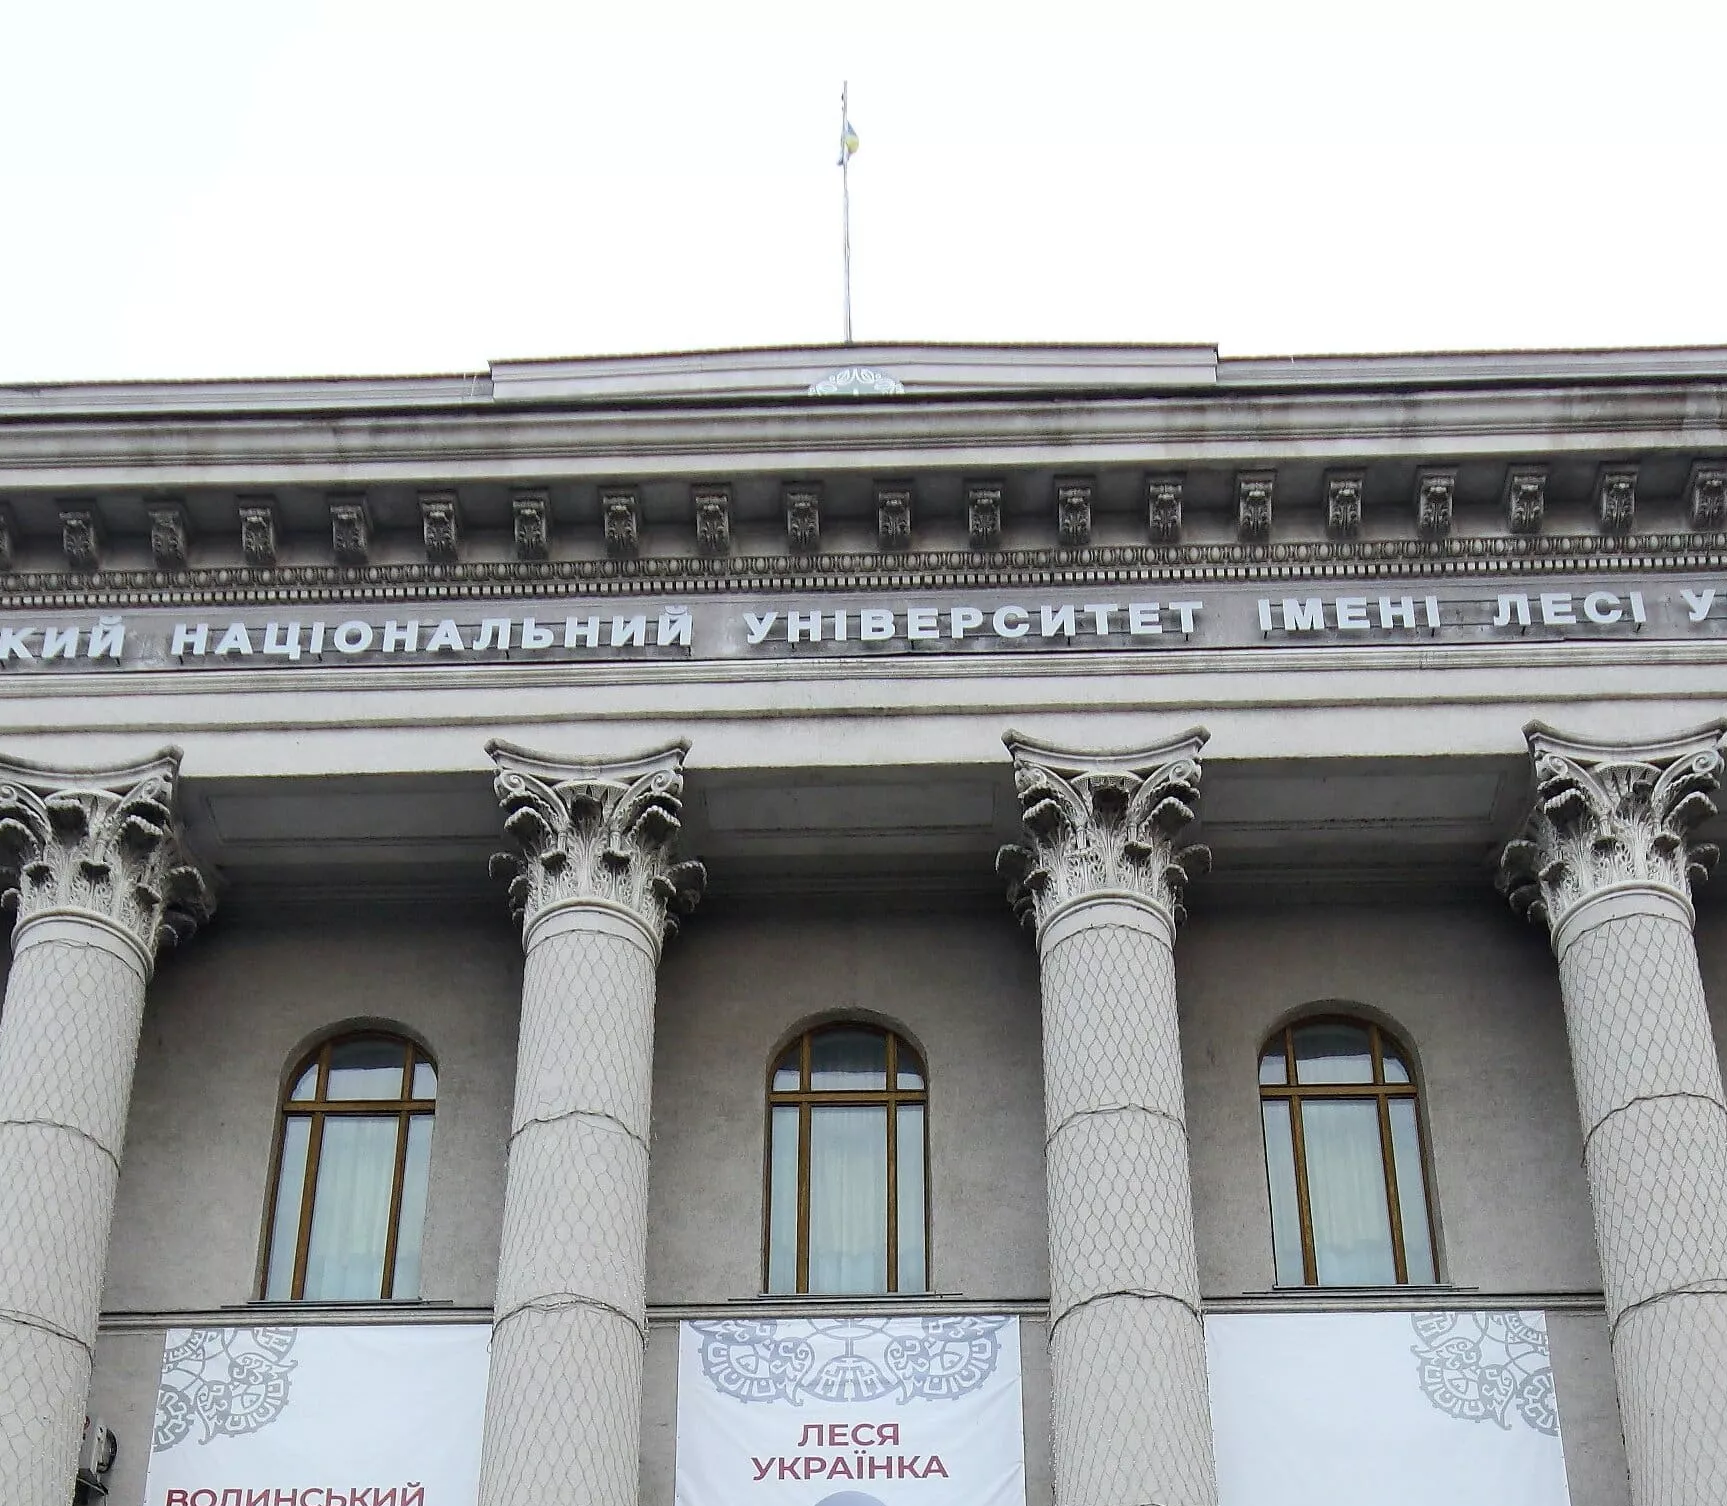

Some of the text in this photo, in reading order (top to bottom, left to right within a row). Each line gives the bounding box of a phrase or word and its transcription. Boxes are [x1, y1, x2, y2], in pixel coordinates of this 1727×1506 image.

[171, 606, 694, 660] НАЦІОНАЛЬНИЙ
[742, 601, 1204, 645] УНІВЕРСИТЕТ
[1258, 595, 1441, 631] ІМЕНІ
[1493, 591, 1647, 627] ЛЕСІ
[797, 1423, 900, 1447] ЛЕСЯ
[751, 1450, 949, 1481] УКРАЇНКА
